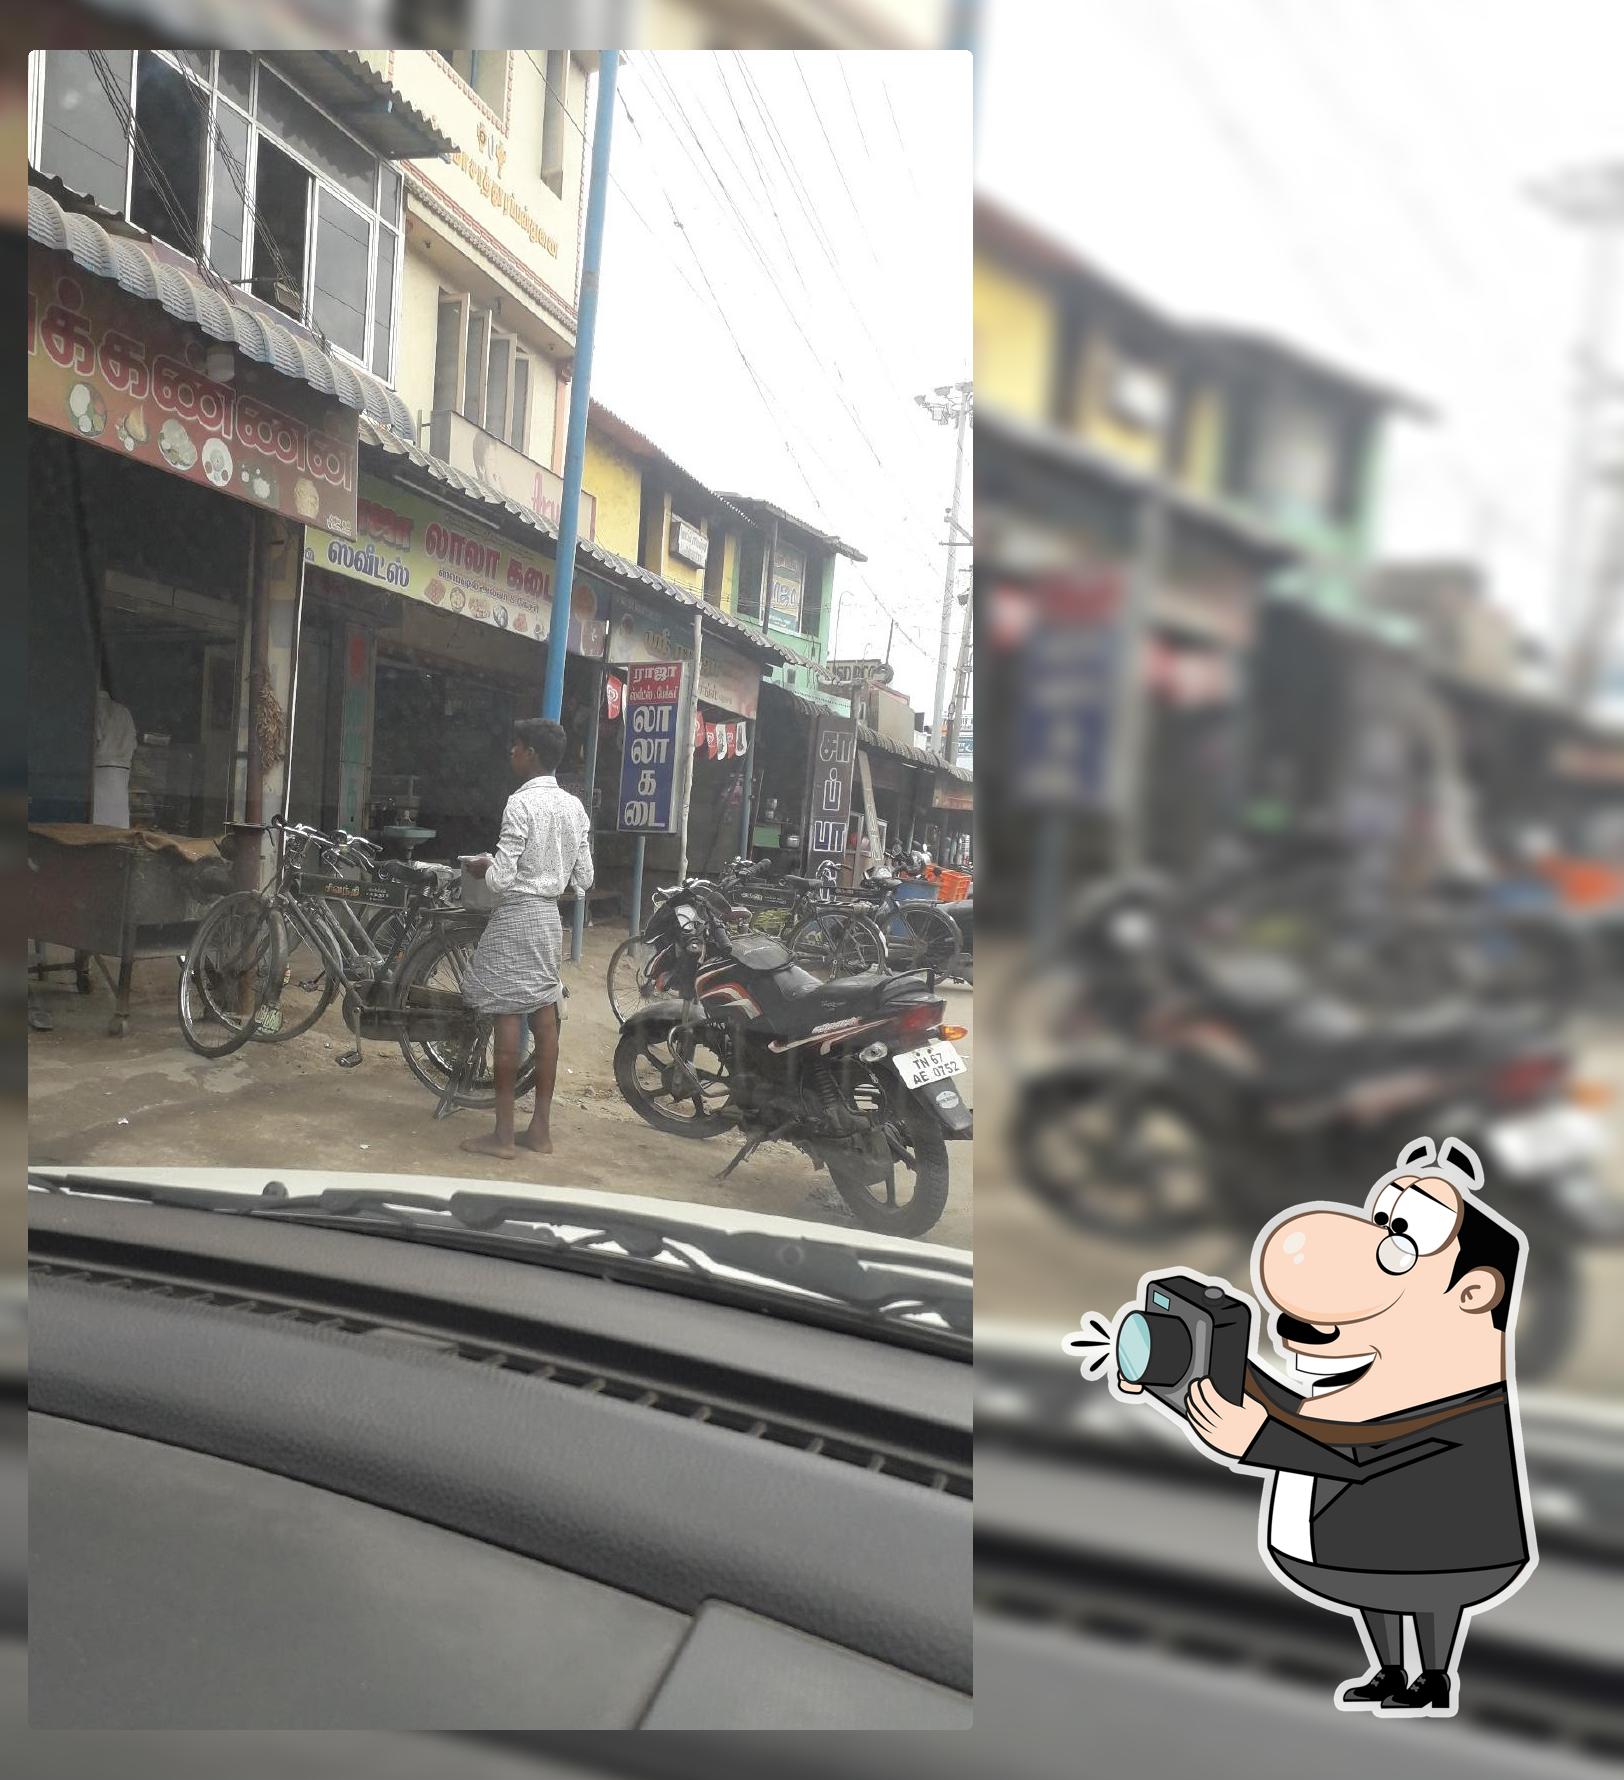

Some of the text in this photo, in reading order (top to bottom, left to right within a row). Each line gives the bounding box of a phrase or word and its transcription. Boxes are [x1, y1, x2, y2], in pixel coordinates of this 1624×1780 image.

[425, 522, 500, 580] லாலா
[633, 666, 678, 683] ராஜா
[913, 1053, 943, 1070] TN 67
[913, 1061, 960, 1085] AE 0752
